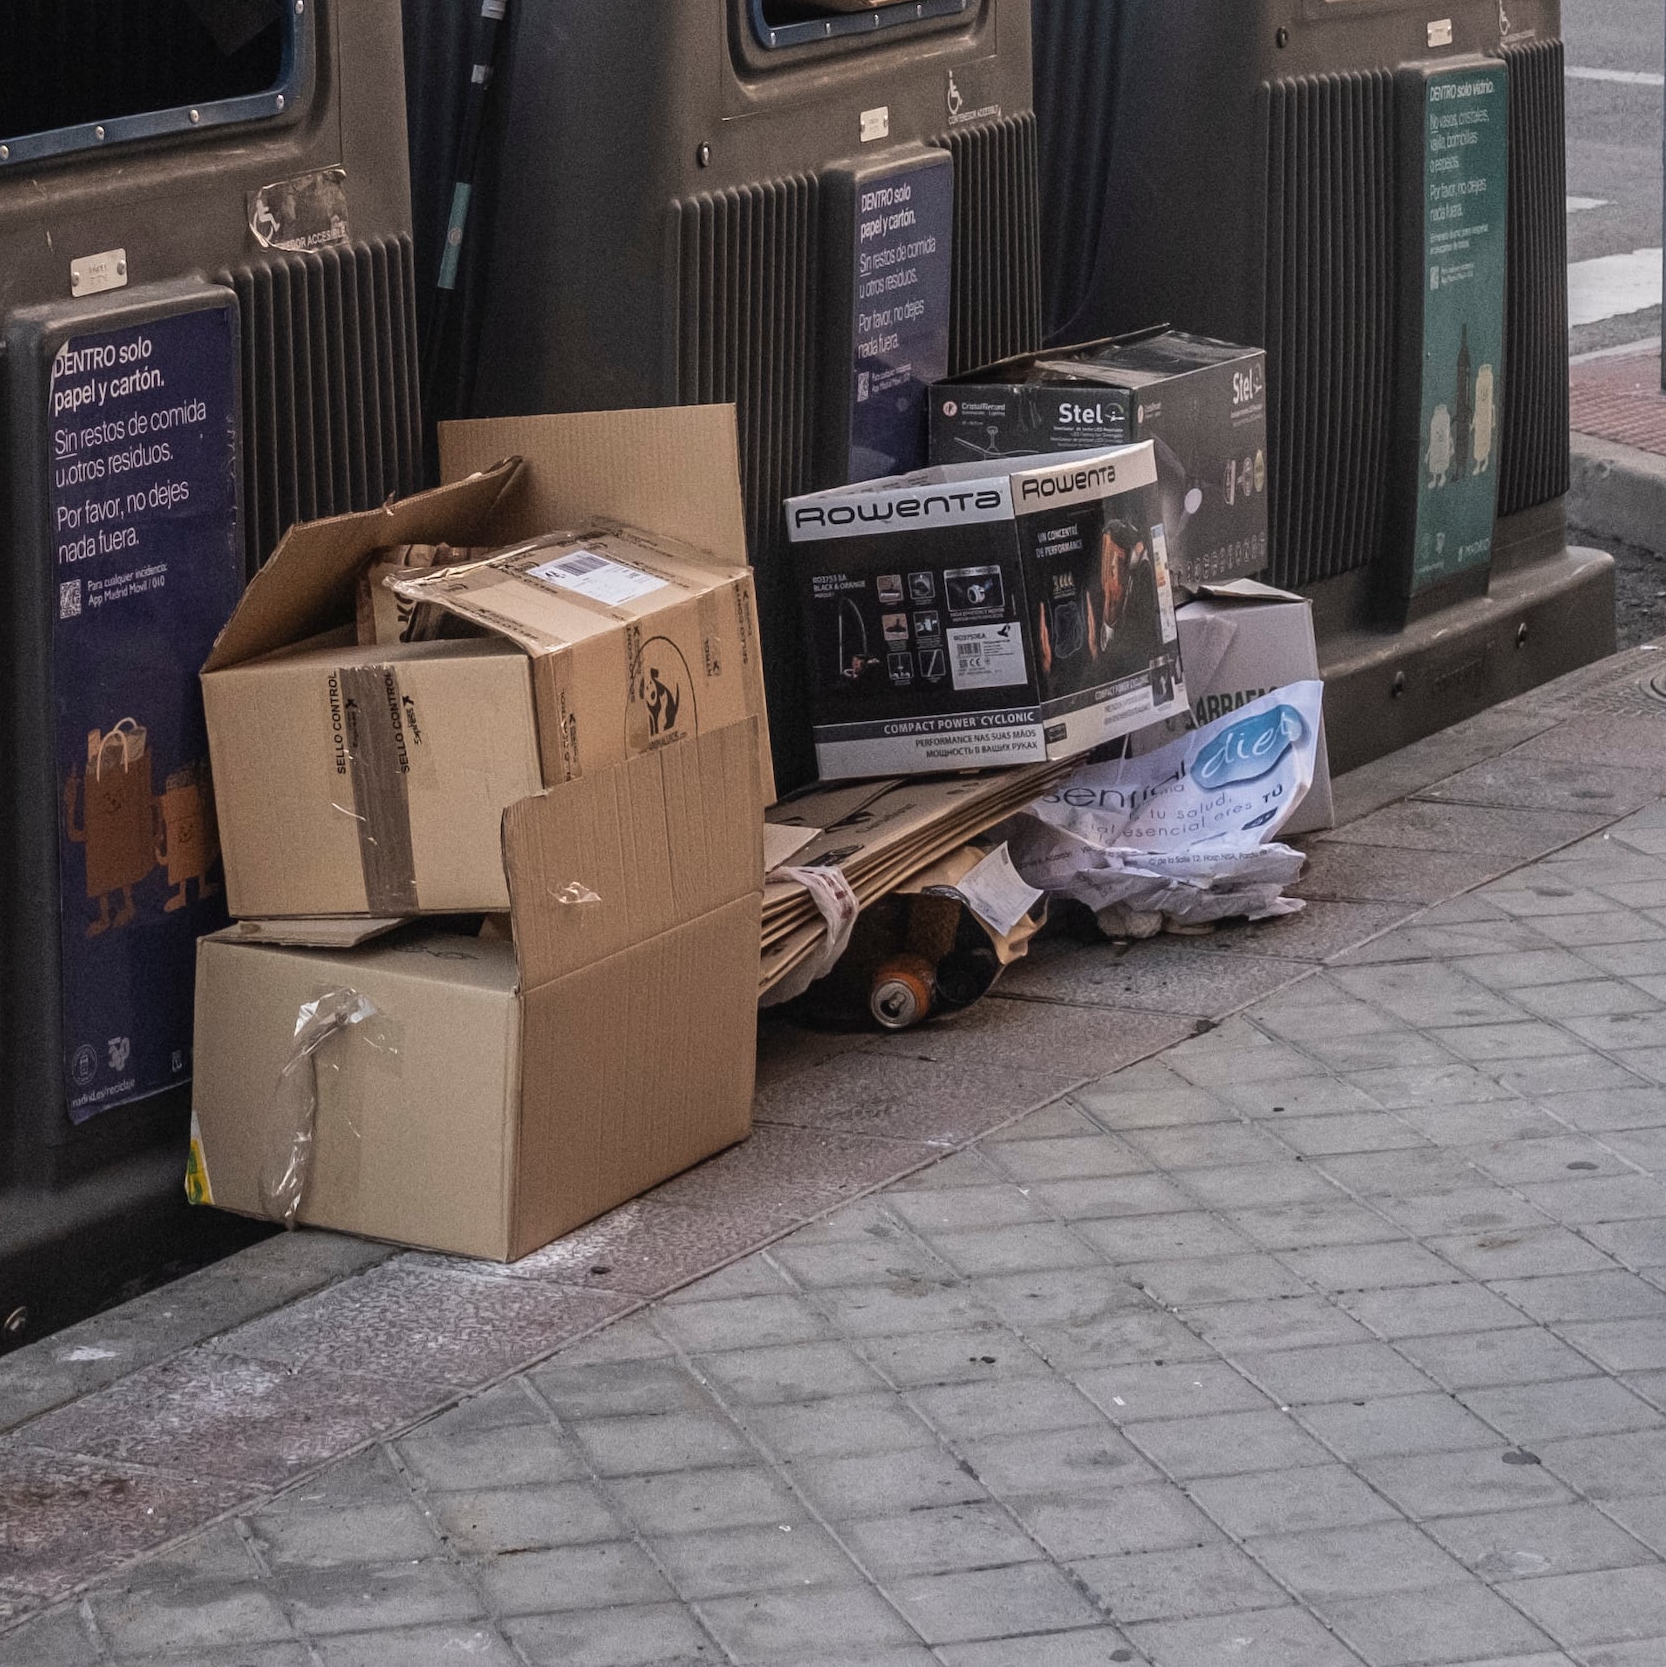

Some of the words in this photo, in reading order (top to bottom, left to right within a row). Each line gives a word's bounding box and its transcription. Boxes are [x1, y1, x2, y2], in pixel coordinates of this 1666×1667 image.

[861, 188, 893, 213] DENTRO
[894, 183, 911, 204] solo
[860, 214, 882, 243] papel
[882, 217, 889, 237] y
[860, 253, 871, 274] Sin
[872, 248, 895, 269] restos
[896, 243, 907, 262] de
[907, 236, 936, 259] comida
[859, 287, 865, 299] u
[865, 278, 884, 296] otros
[859, 313, 873, 334] Por
[873, 309, 893, 329] favor,
[893, 306, 903, 322] no
[904, 299, 925, 322] dejes
[54, 345, 116, 379] DENTRO
[119, 336, 152, 364] solo
[858, 337, 878, 359] nada
[55, 382, 95, 416] papel
[98, 382, 107, 407] y
[110, 366, 165, 398] cartón.
[1233, 370, 1253, 405] Stel
[55, 430, 78, 457] Sin
[80, 421, 126, 449] restos
[128, 411, 147, 437] de
[150, 398, 207, 431] comida
[1059, 403, 1103, 424] Stel
[108, 442, 174, 475] residuos.
[57, 506, 82, 531] Por
[85, 496, 124, 524] favor,
[126, 490, 146, 513] no
[148, 480, 190, 510] dejes
[58, 535, 96, 564] nada
[98, 526, 139, 554] fuera.
[87, 580, 103, 592] Para
[104, 573, 134, 587] cualquier
[88, 594, 103, 608] App
[104, 585, 128, 602] Madrid
[152, 575, 165, 588] 010
[328, 671, 342, 731] CONTROL
[383, 672, 402, 730] CONTROL
[883, 720, 935, 734] COMPACT
[980, 712, 1035, 725] CYCLONIC
[915, 735, 972, 747] PERFORMANCE
[974, 734, 990, 742] NAS
[991, 731, 1011, 740] SUAS
[334, 734, 347, 774] SELLO
[395, 733, 411, 773] SELLO
[1122, 818, 1205, 838] esencial
[1213, 802, 1253, 821] eres
[1261, 784, 1283, 804] TÚ
[1176, 792, 1233, 820] salud,
